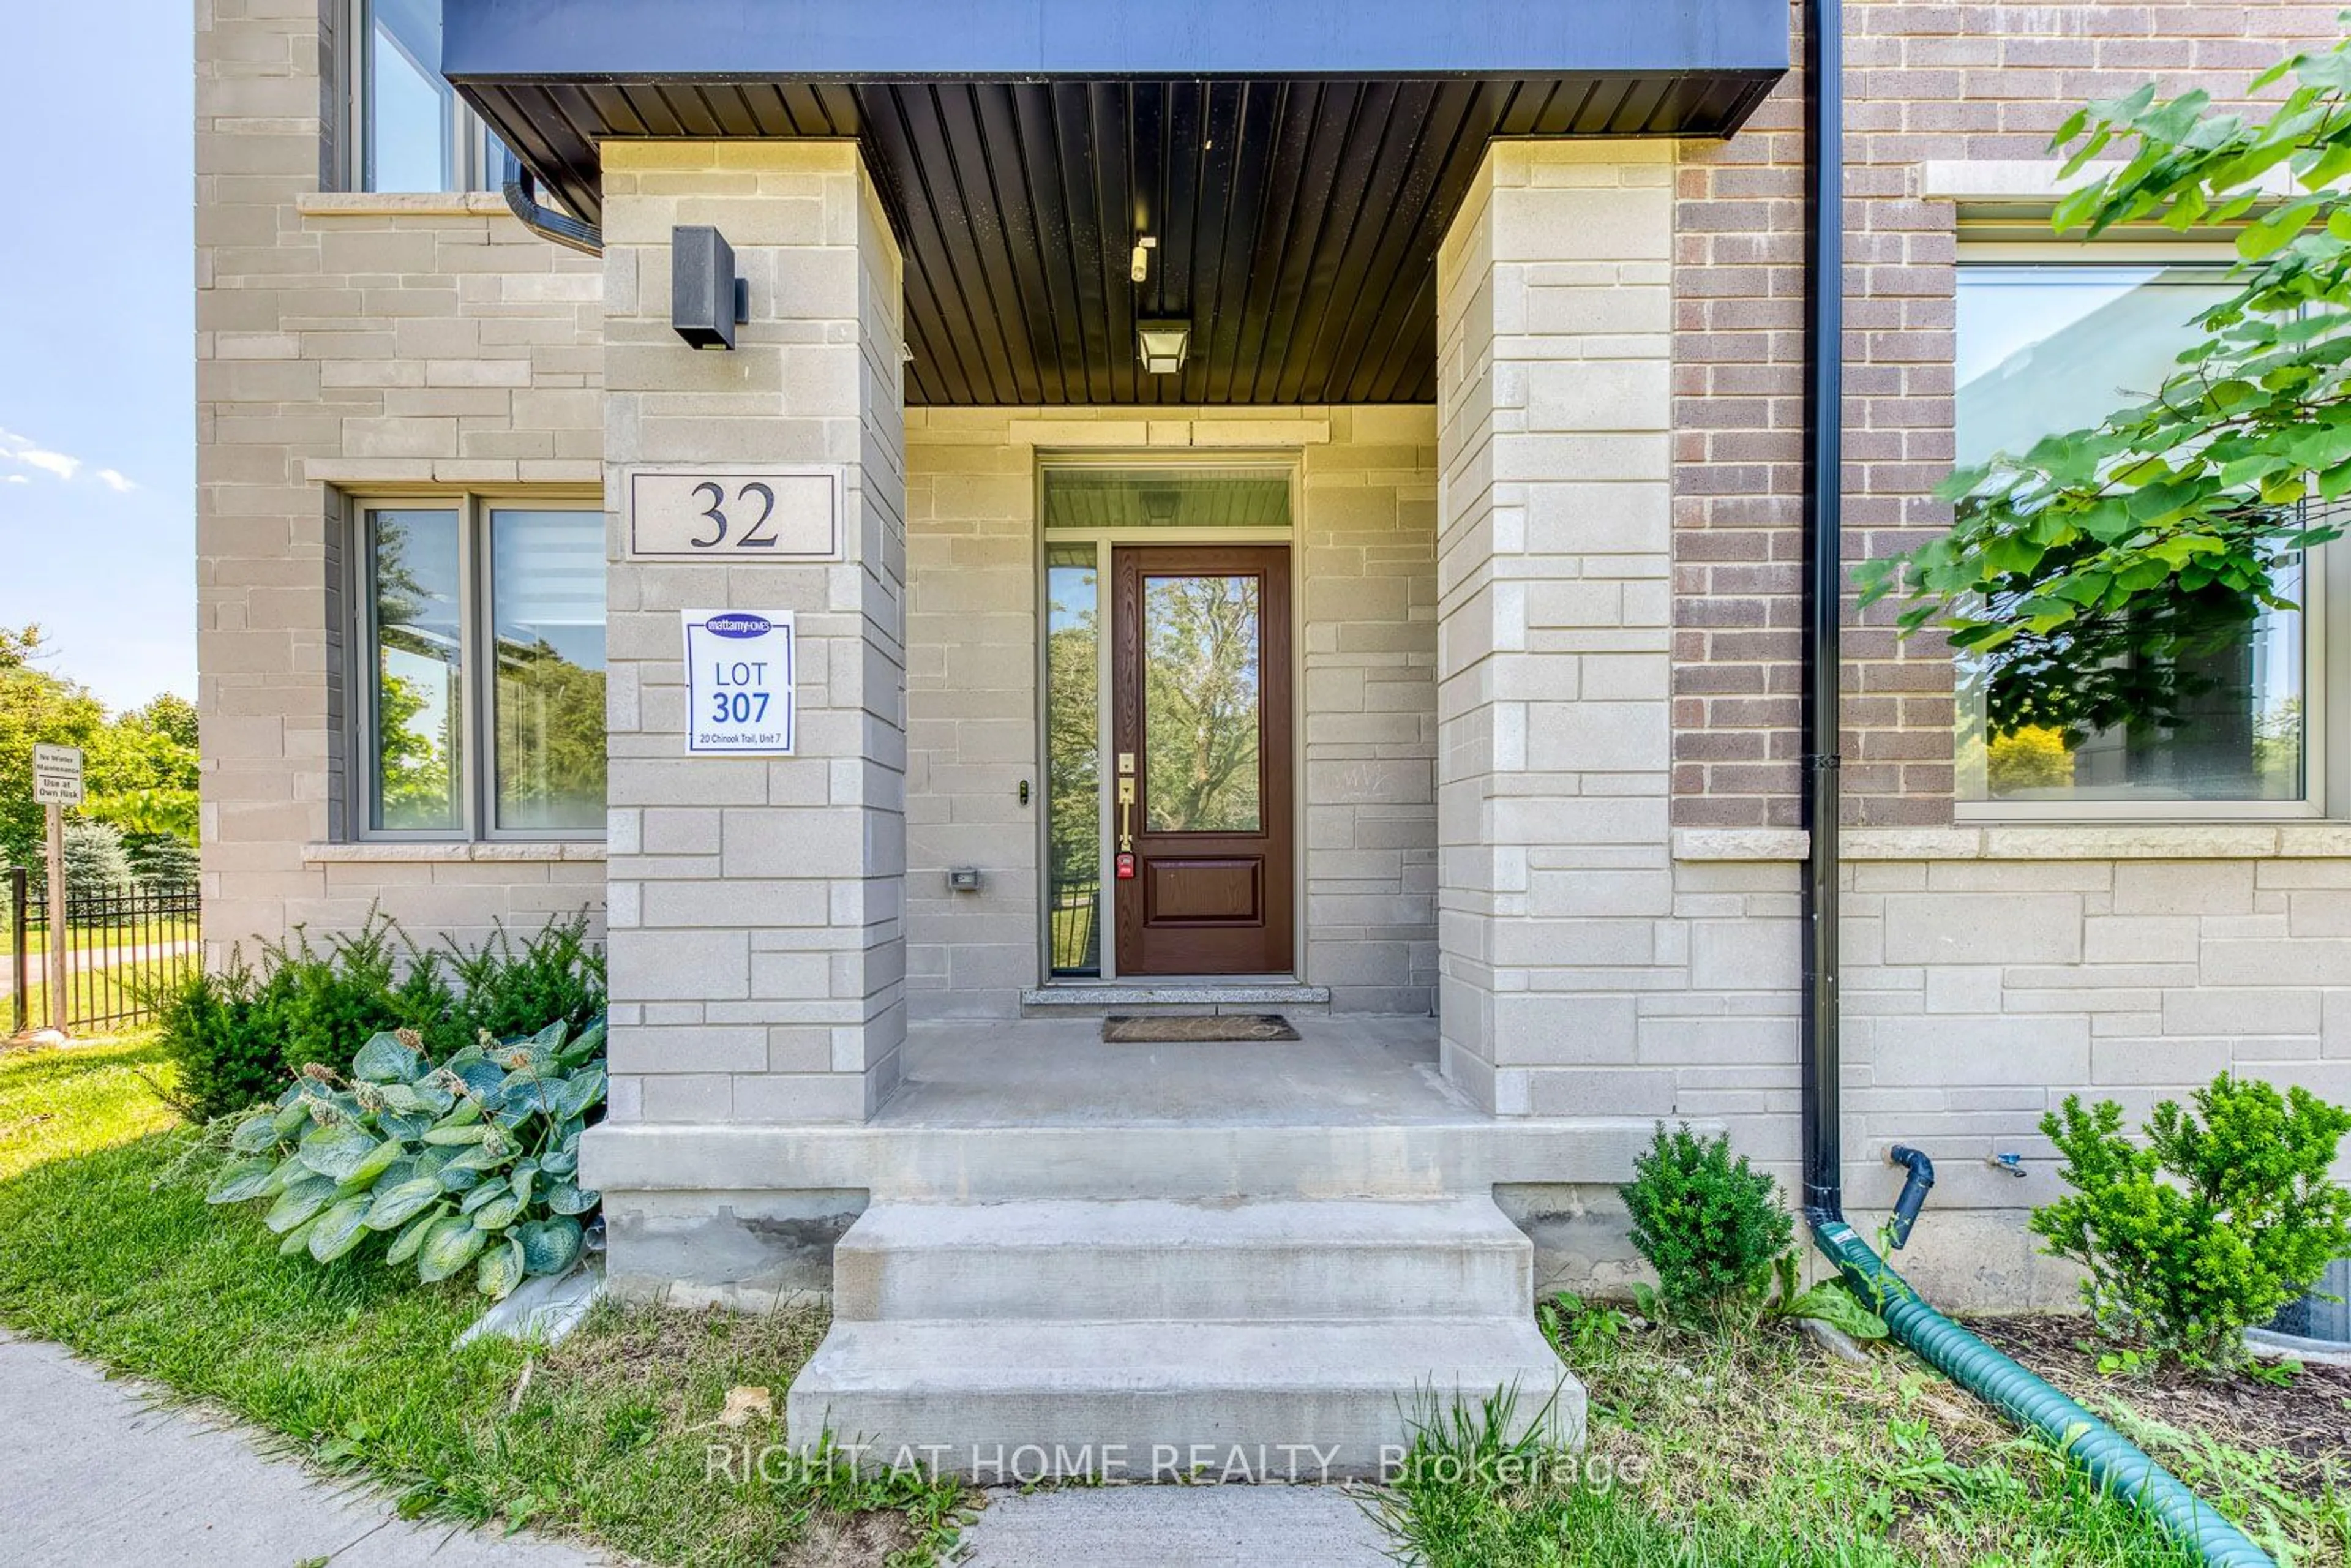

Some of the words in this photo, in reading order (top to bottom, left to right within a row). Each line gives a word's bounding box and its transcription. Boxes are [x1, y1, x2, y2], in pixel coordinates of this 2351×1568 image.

[690, 482, 779, 547] 32
[716, 662, 768, 686] LOT
[712, 692, 770, 723] 307
[700, 733, 710, 743] 20
[711, 733, 738, 743] Chinook
[741, 733, 757, 745] Trail,
[760, 733, 774, 743] Unit
[776, 733, 781, 743] 7
[39, 788, 58, 797] Own
[60, 790, 79, 798] Risk
